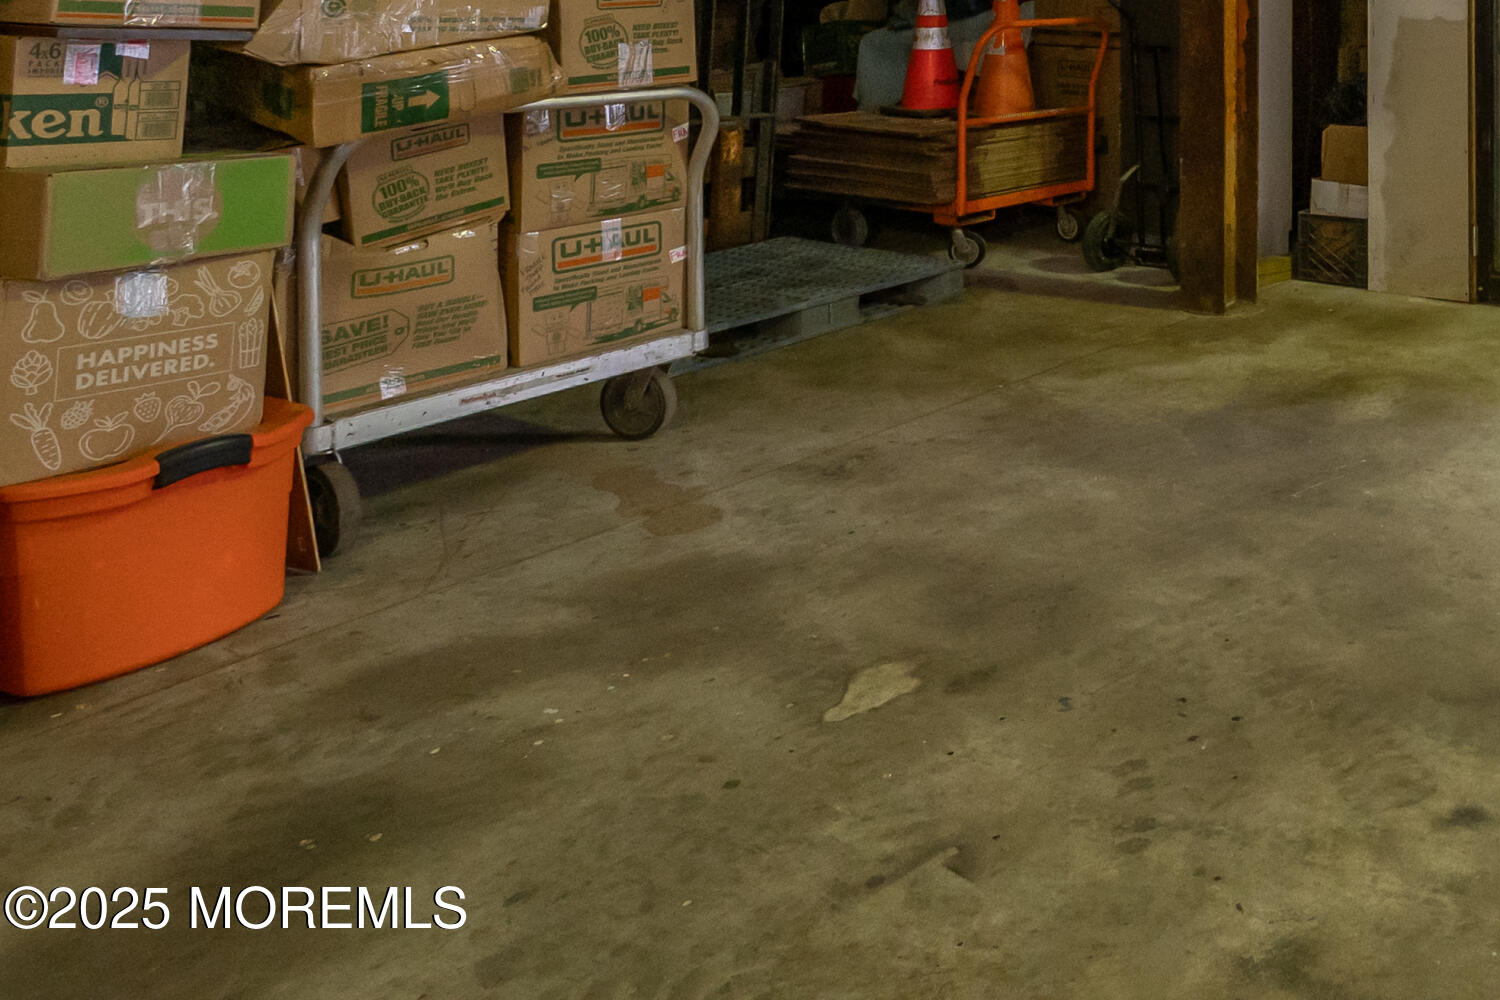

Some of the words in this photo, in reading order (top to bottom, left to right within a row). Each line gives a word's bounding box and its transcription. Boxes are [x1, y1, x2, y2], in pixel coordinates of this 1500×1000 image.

[584, 25, 621, 44] 100%
[28, 42, 62, 60] 4x6
[375, 86, 389, 128] FRAGILE
[396, 128, 465, 151] U-HAUL
[380, 175, 420, 199] 100%
[359, 261, 449, 287] U-HAUL
[322, 314, 389, 346] SAVE!
[76, 333, 219, 371] HAPPINESS
[323, 343, 347, 361] EST
[352, 334, 388, 351] PRICE
[74, 354, 216, 391] DELIVERED.
